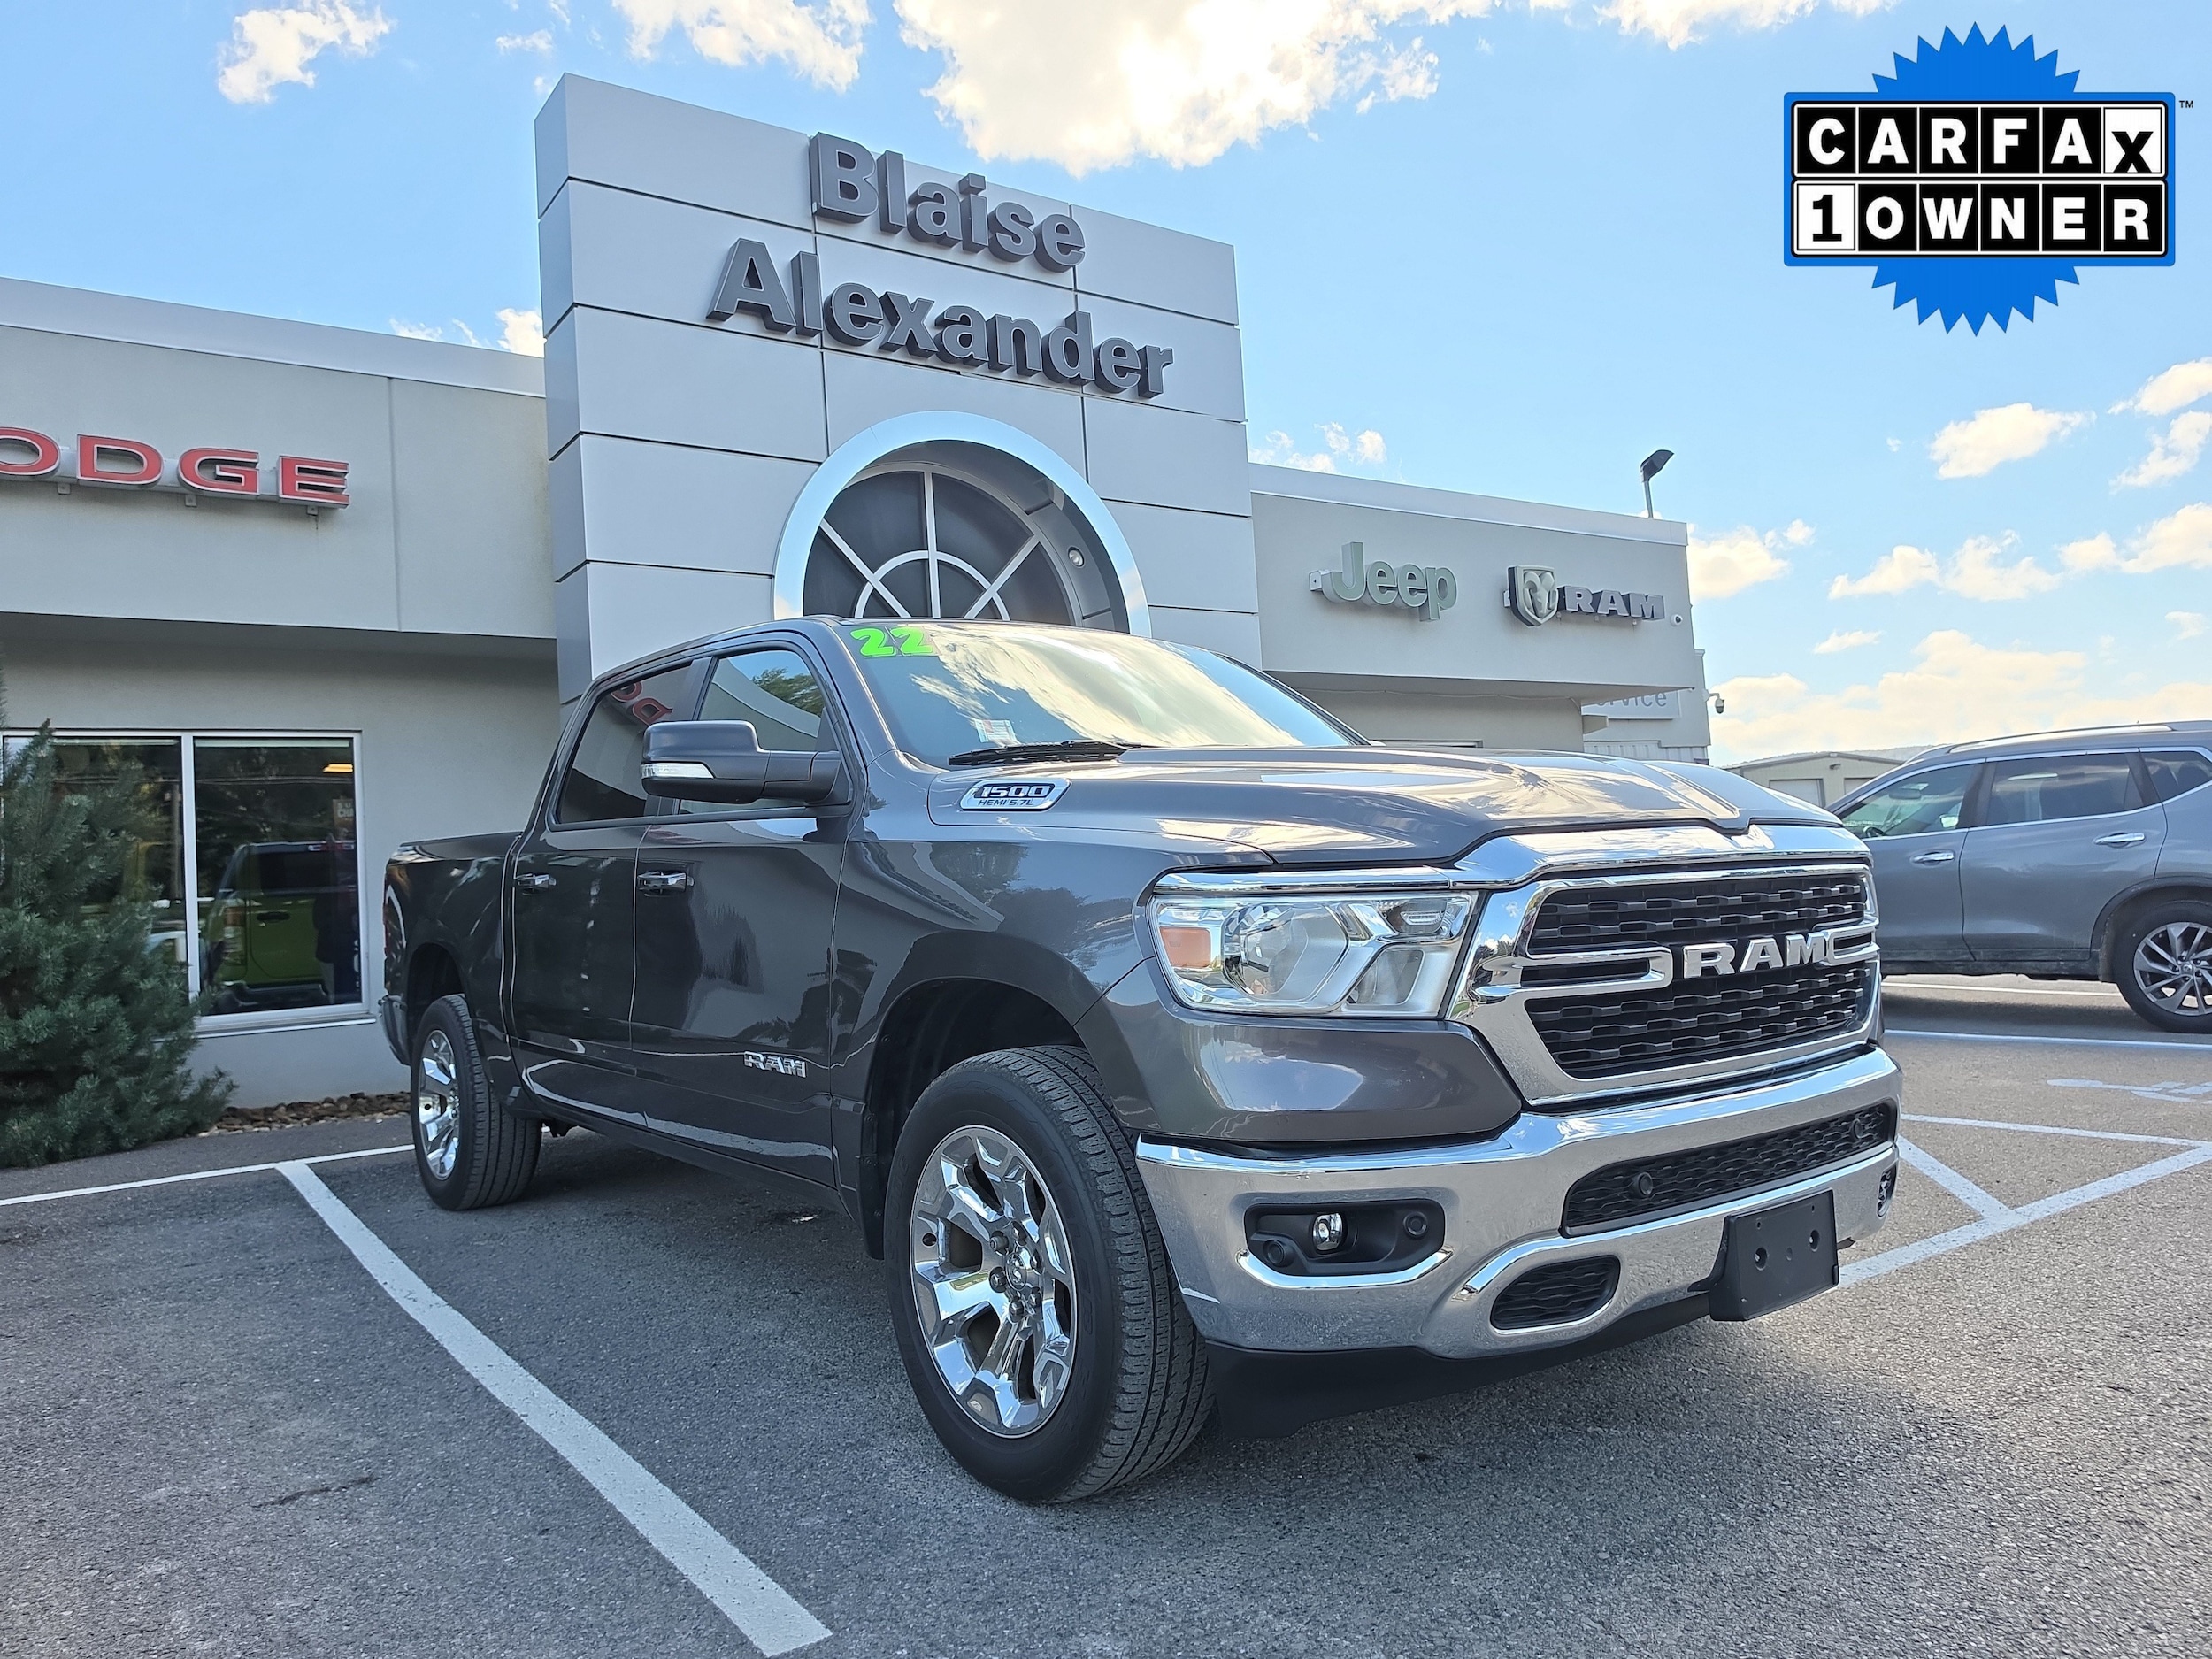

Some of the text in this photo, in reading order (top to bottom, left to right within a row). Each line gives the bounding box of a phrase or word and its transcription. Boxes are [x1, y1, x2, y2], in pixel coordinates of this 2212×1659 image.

[809, 132, 1087, 273] Blaise
[706, 237, 1173, 398] Alexander
[1325, 541, 1458, 621] Jeep
[1560, 585, 1666, 620] RAM
[850, 627, 934, 657] 22
[981, 785, 1051, 797] 1500
[1684, 931, 1826, 979] RAM
[744, 1050, 807, 1078] RAM
